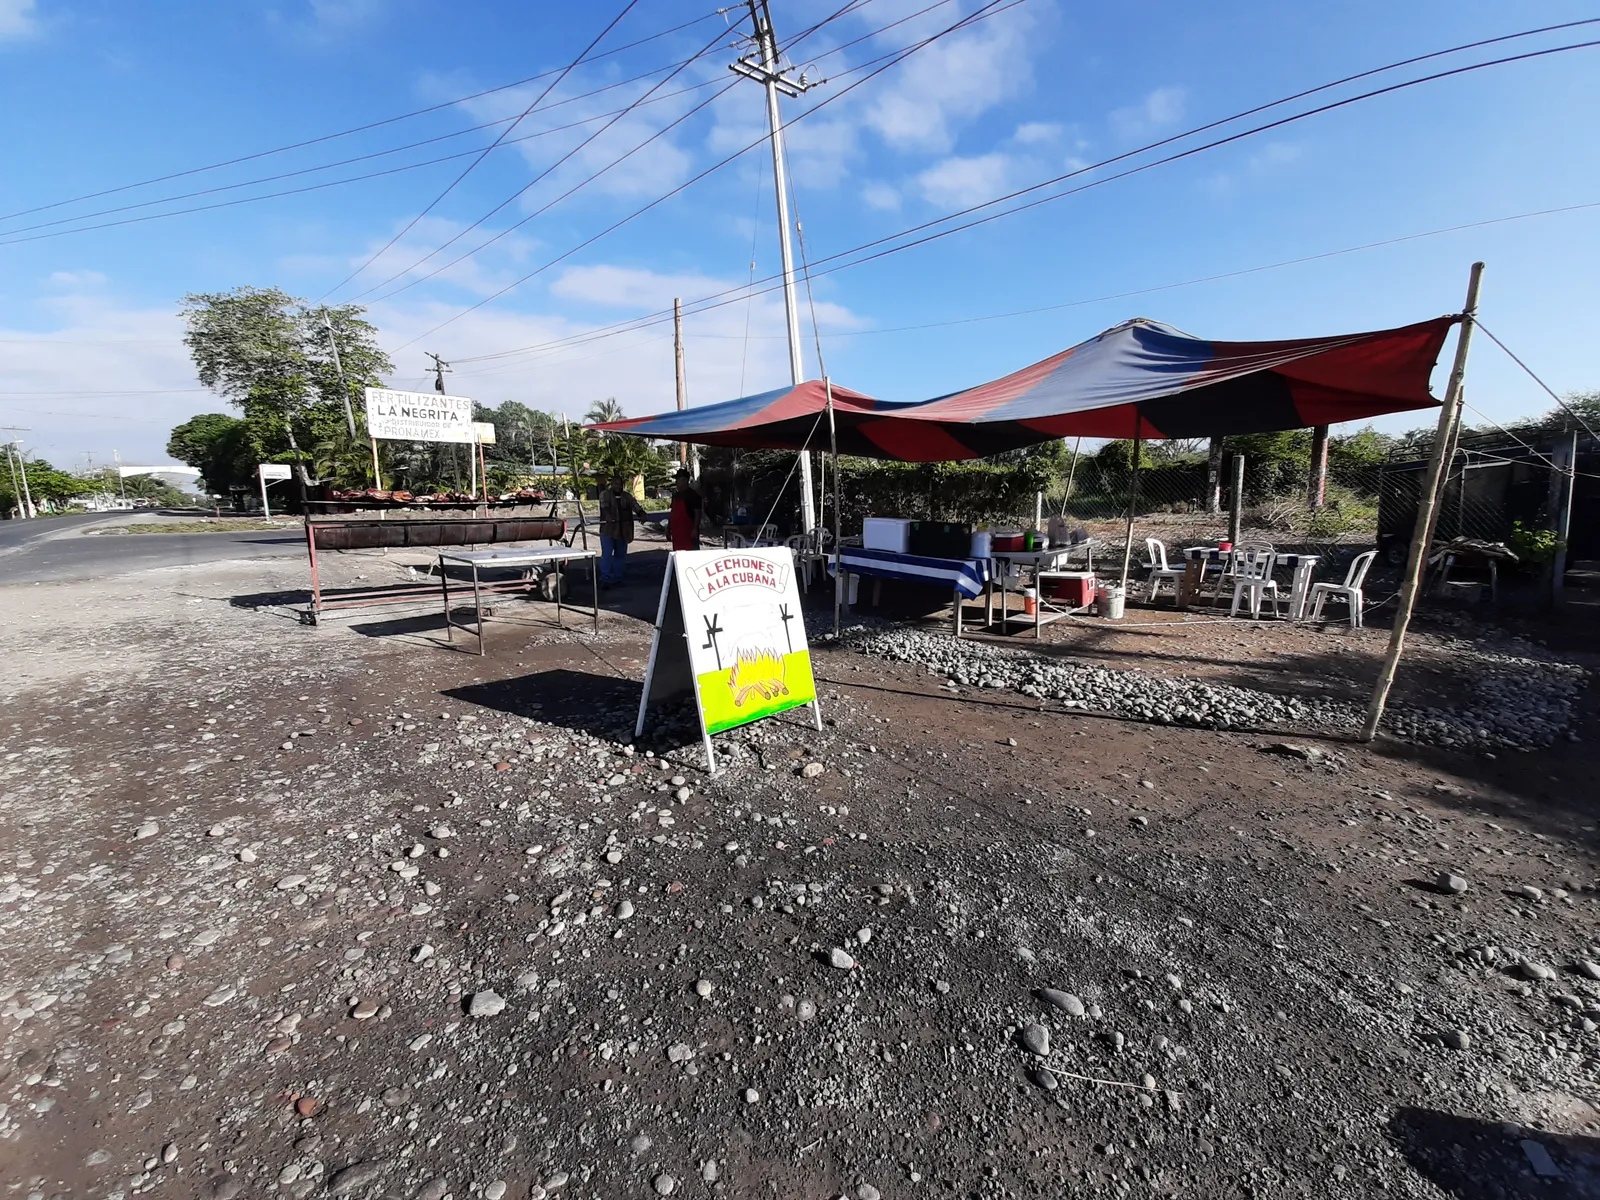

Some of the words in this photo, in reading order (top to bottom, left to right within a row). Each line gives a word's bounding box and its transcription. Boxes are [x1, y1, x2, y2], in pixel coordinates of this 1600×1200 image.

[371, 390, 470, 410] FERTILIZANTES
[377, 405, 397, 417] LA
[401, 407, 459, 421] NEGRITA
[705, 558, 774, 577] LECHONES
[707, 582, 716, 594] A
[716, 575, 731, 589] LA
[731, 572, 777, 588] CUBANA
